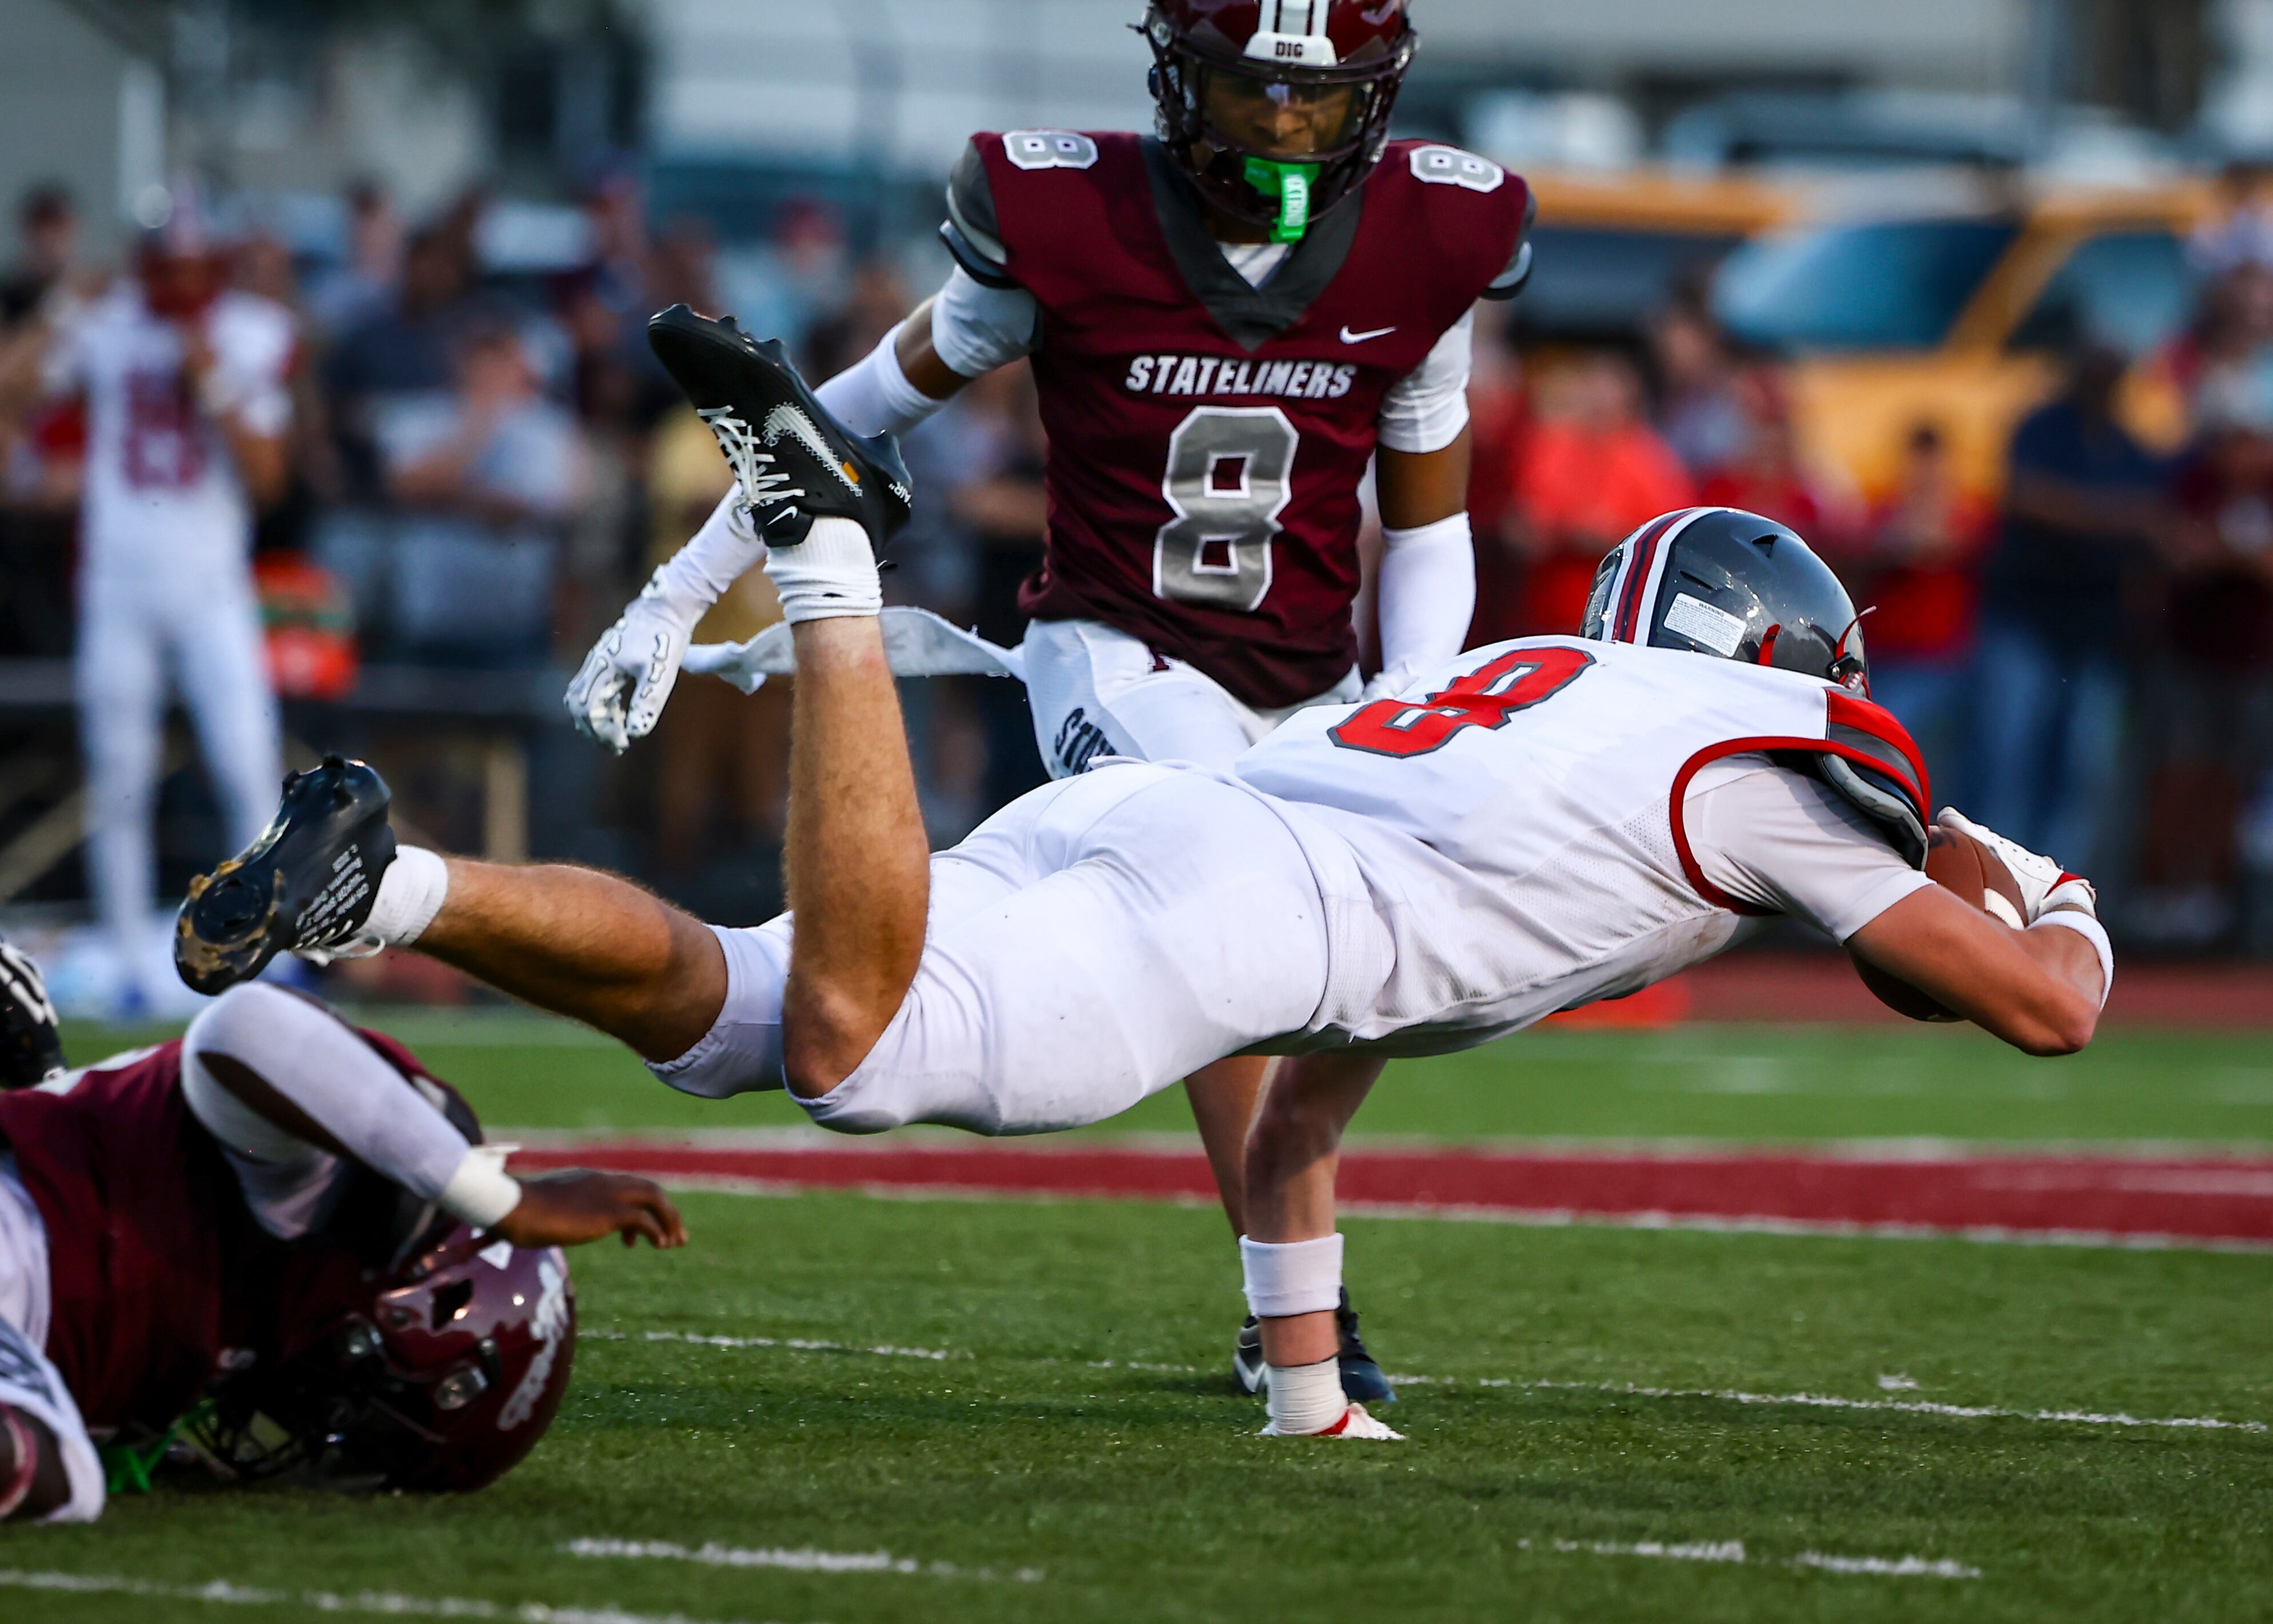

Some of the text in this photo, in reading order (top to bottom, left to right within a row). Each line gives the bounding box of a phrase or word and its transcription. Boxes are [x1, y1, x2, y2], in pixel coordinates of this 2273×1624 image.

[1276, 42, 1303, 58] DIG
[1002, 130, 1099, 170] 8
[1410, 144, 1504, 193] 8
[1125, 355, 1359, 399] STATELINERS
[1152, 405, 1299, 612] 8
[1698, 602, 1725, 617] WARNING
